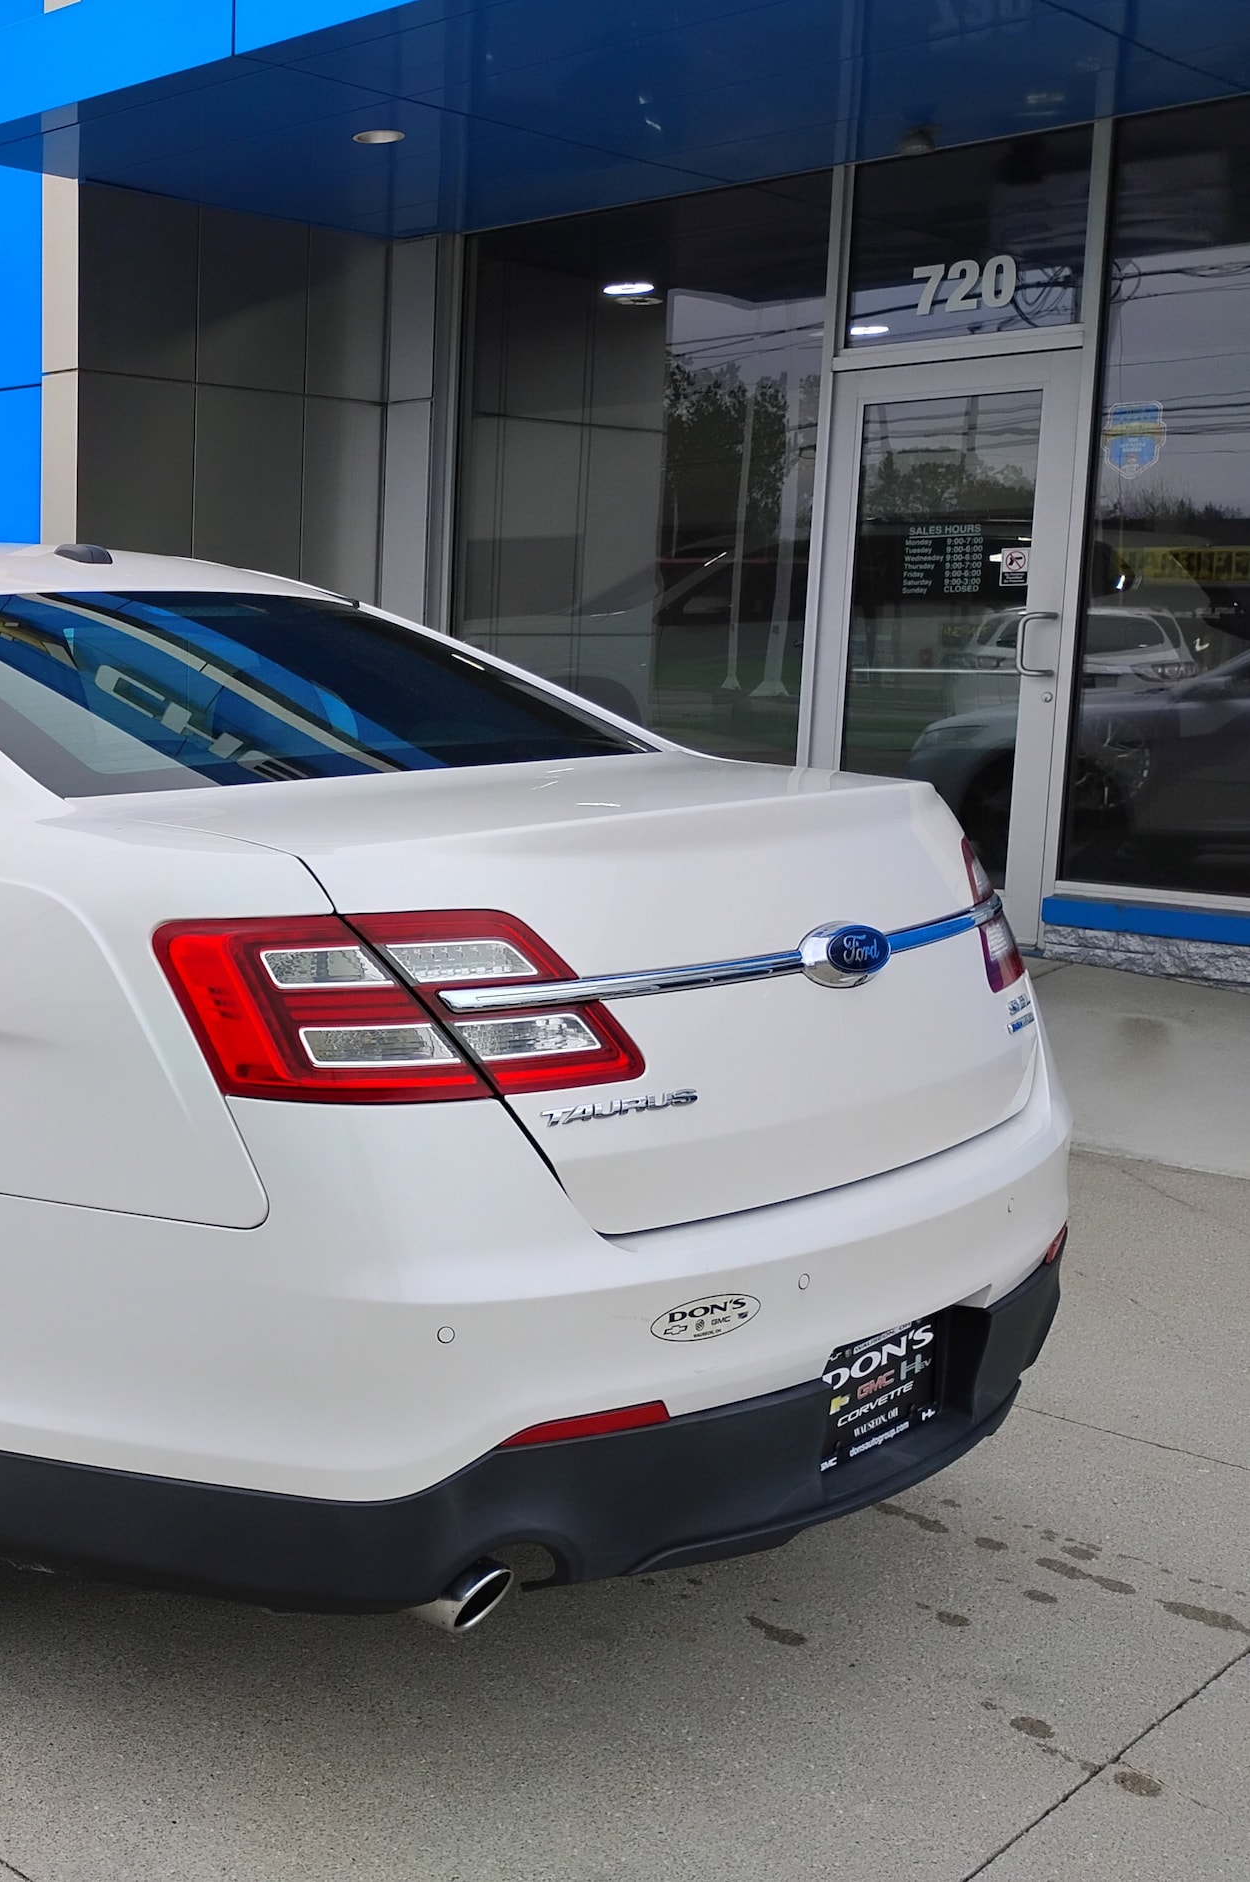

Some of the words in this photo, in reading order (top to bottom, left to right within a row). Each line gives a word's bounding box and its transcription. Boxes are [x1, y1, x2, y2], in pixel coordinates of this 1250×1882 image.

[912, 254, 1018, 317] 720
[908, 525, 943, 536] SALES
[944, 523, 982, 535] HOURS
[905, 538, 933, 546] Monday
[946, 537, 984, 545] 9:00-7:00
[904, 546, 933, 555] Tuesday
[904, 554, 944, 563] Wednesday
[904, 562, 935, 571] Thursday
[944, 561, 982, 570] 9:00-7:00
[903, 570, 925, 579] Friday
[902, 579, 933, 587] Saturday
[901, 586, 928, 595] Sunday
[943, 584, 980, 593] CLOSED
[842, 934, 879, 965] Ford
[540, 1088, 699, 1128] TAURUS
[668, 1297, 747, 1324] DON'S
[710, 1315, 732, 1326] GMC
[821, 1324, 934, 1390] DON'S
[857, 1369, 895, 1400] GMC
[837, 1380, 915, 1428] CORVETTE
